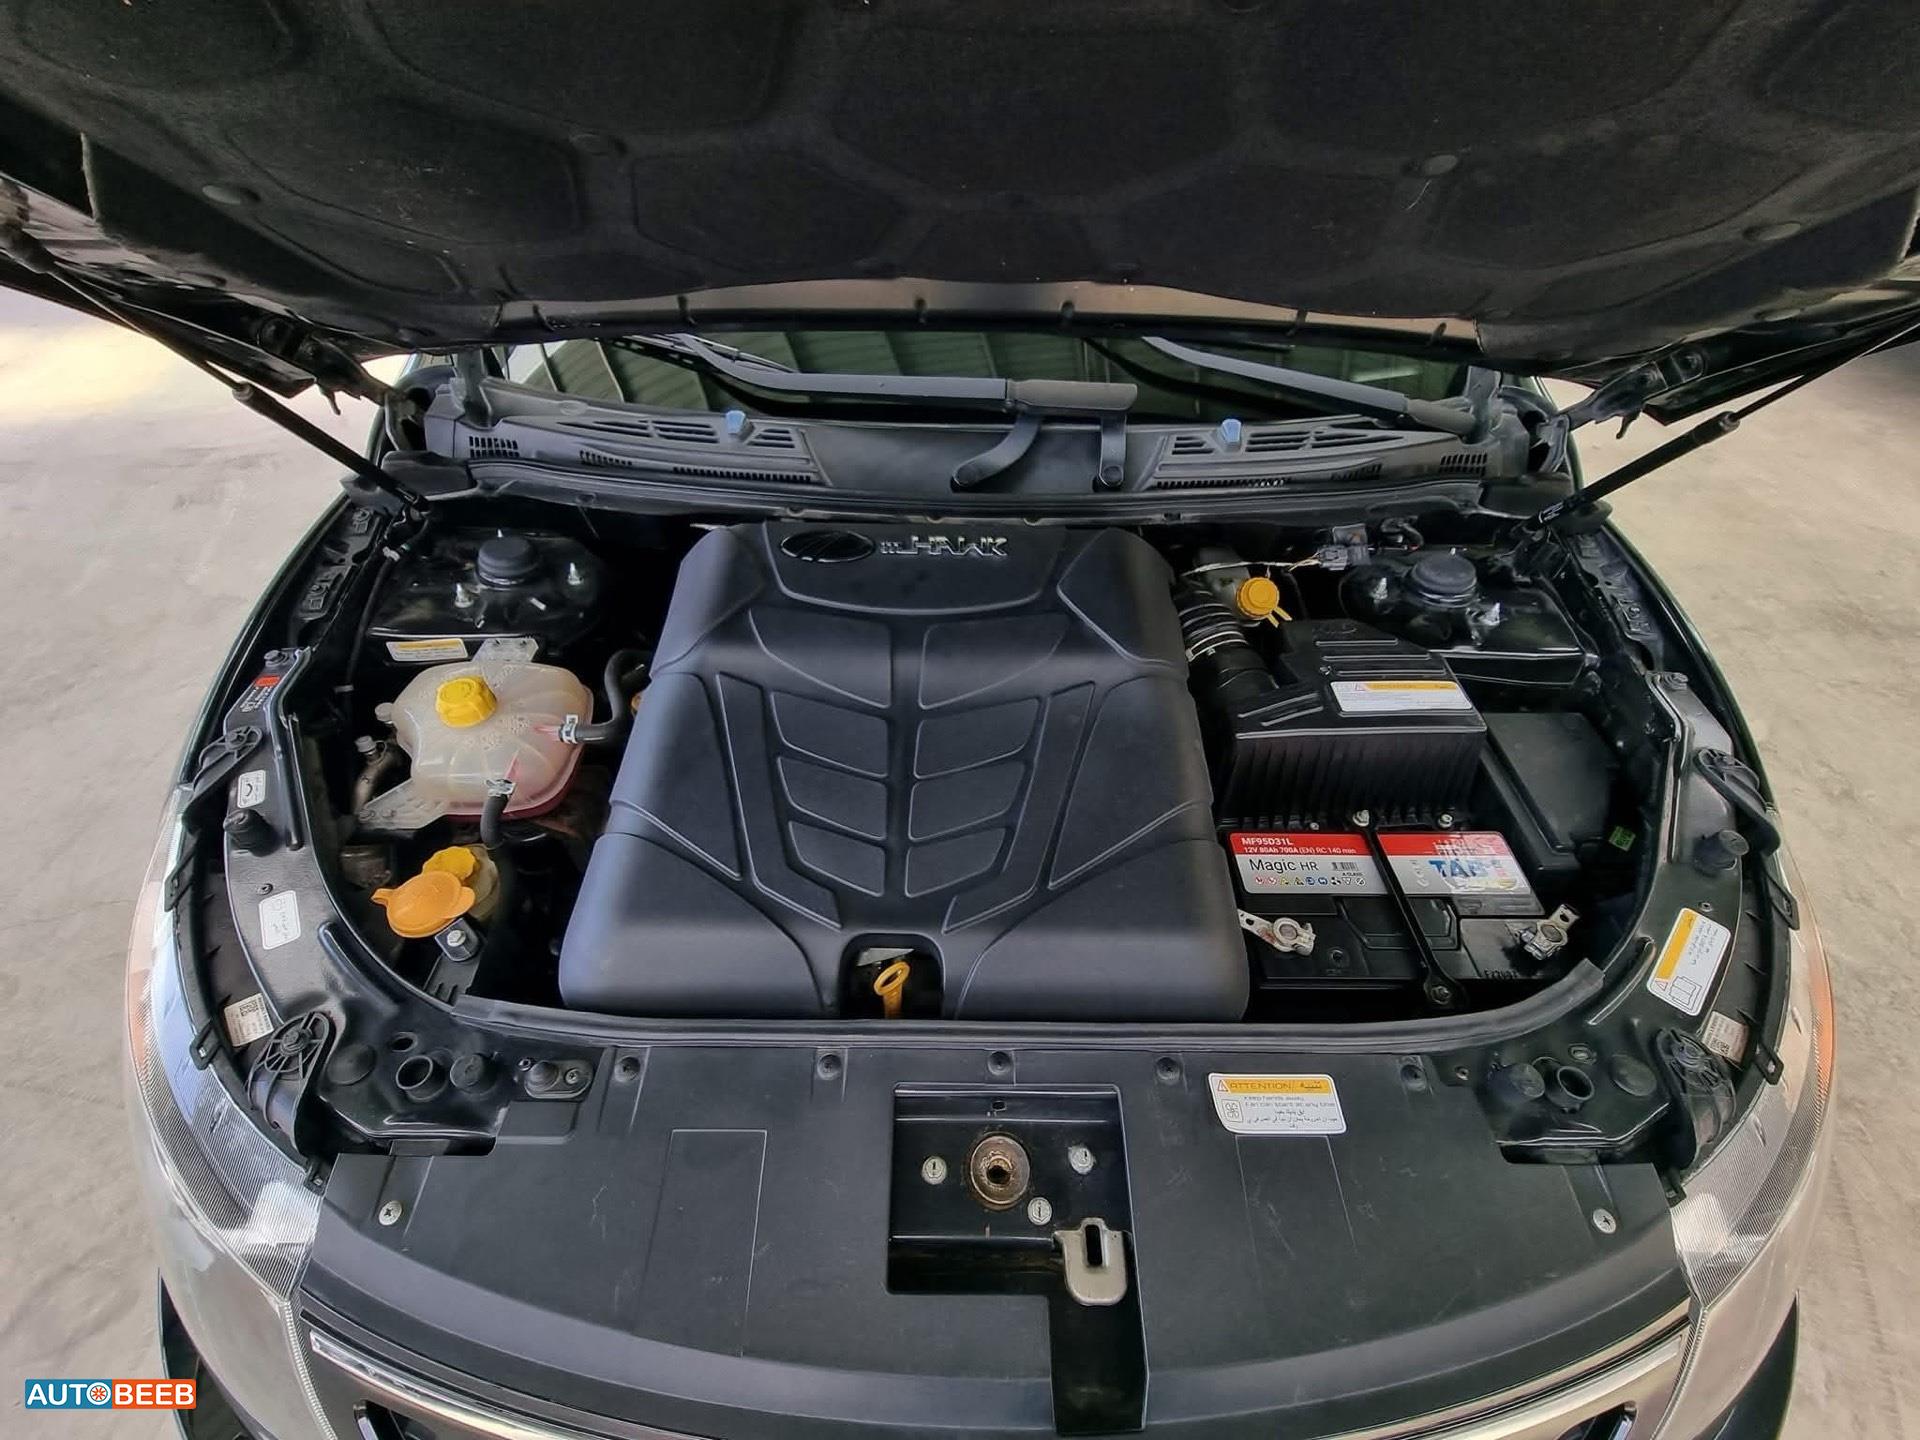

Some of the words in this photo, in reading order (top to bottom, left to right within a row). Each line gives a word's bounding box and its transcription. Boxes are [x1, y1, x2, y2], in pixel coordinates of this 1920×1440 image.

[1241, 837, 1294, 846] MF95D31L
[1249, 858, 1297, 874] Magic
[1300, 861, 1319, 871] HR
[1229, 1082, 1291, 1090] ATTENTION
